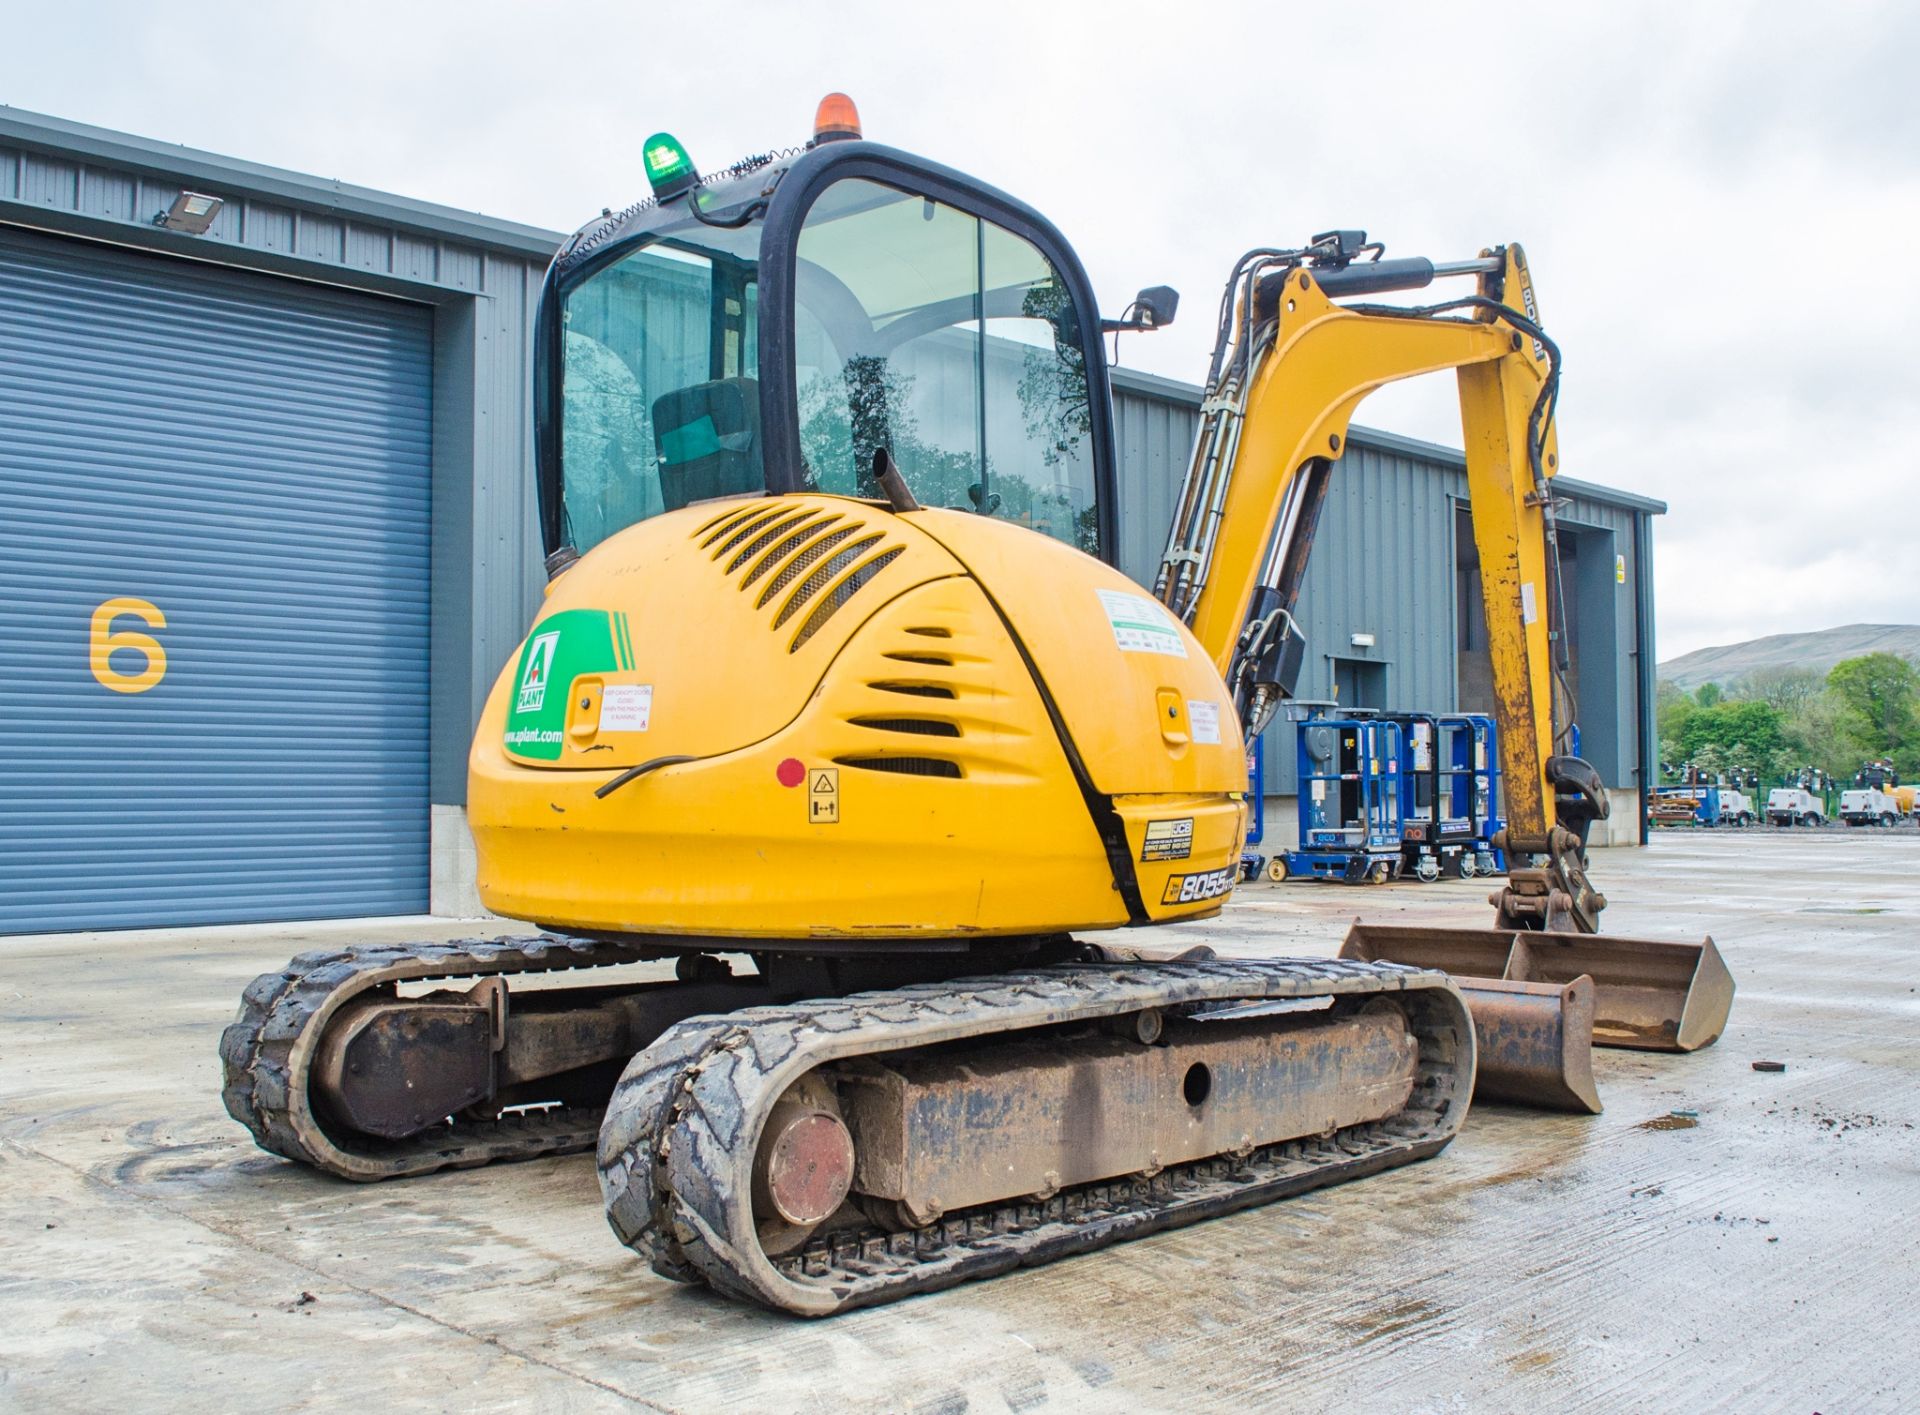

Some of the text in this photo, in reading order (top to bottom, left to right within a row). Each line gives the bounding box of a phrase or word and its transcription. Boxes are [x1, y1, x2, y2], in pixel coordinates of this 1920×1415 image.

[90, 597, 167, 693] 6
[518, 690, 542, 706] PLANT
[1173, 823, 1191, 834] JCB
[1179, 870, 1228, 902] 8055
